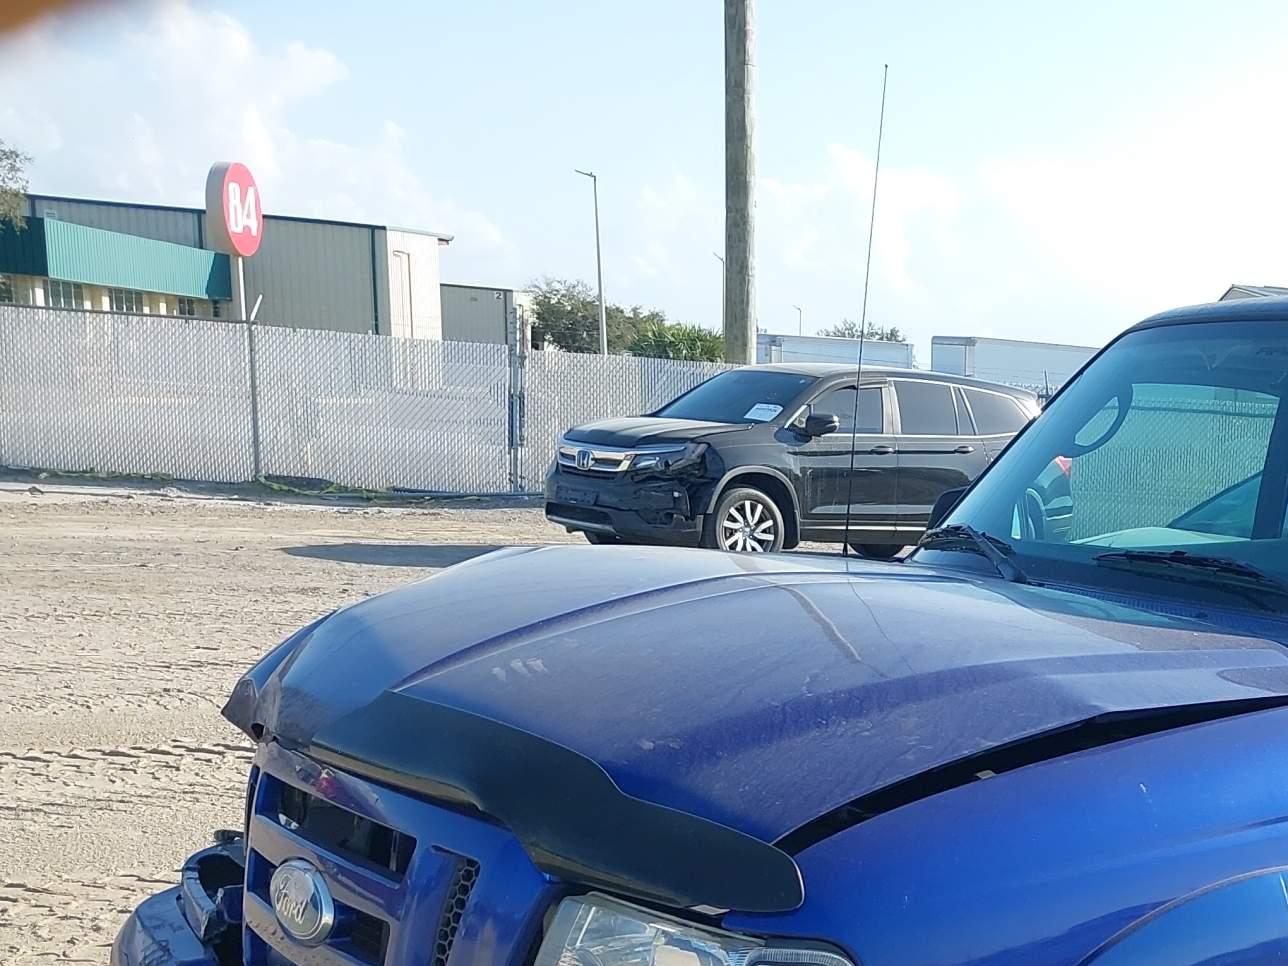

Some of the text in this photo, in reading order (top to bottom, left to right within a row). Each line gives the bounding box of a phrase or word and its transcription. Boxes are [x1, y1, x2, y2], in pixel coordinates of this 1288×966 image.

[228, 182, 258, 237] 84
[495, 291, 503, 300] 2
[275, 873, 307, 924] Ford
